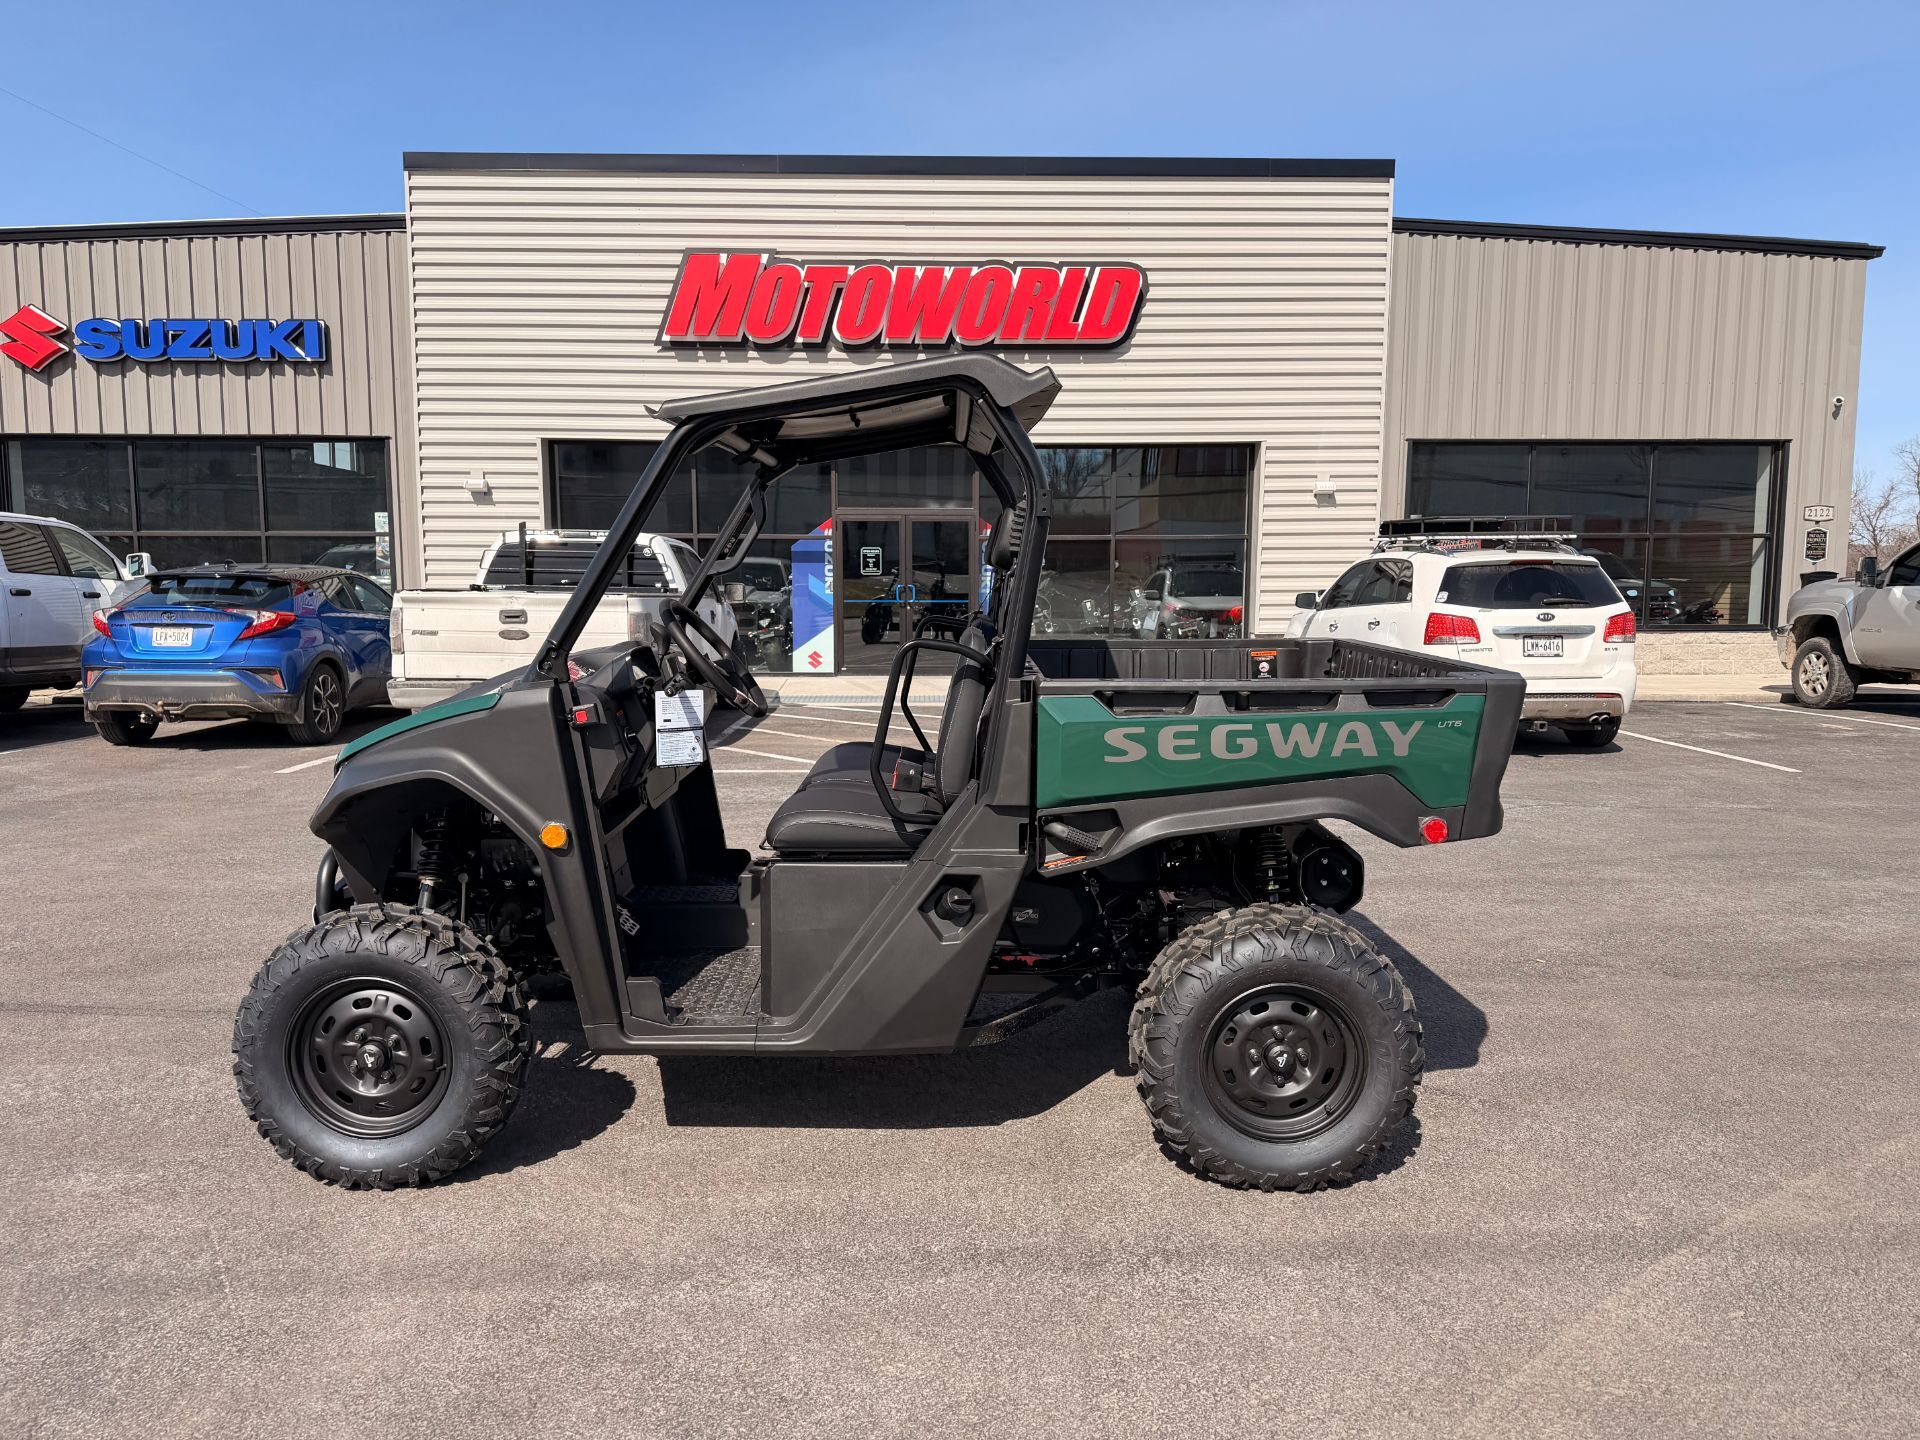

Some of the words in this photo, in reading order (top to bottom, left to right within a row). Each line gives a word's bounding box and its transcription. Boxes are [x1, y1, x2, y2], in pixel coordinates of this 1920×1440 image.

[663, 252, 1141, 343] MOTOWORLD
[74, 318, 324, 361] SUZUKI
[1807, 508, 1830, 517] 2122
[172, 632, 189, 641] 5024
[1543, 641, 1560, 651] 6416
[1437, 720, 1462, 728] UT6
[1103, 720, 1424, 762] SEGWAY
